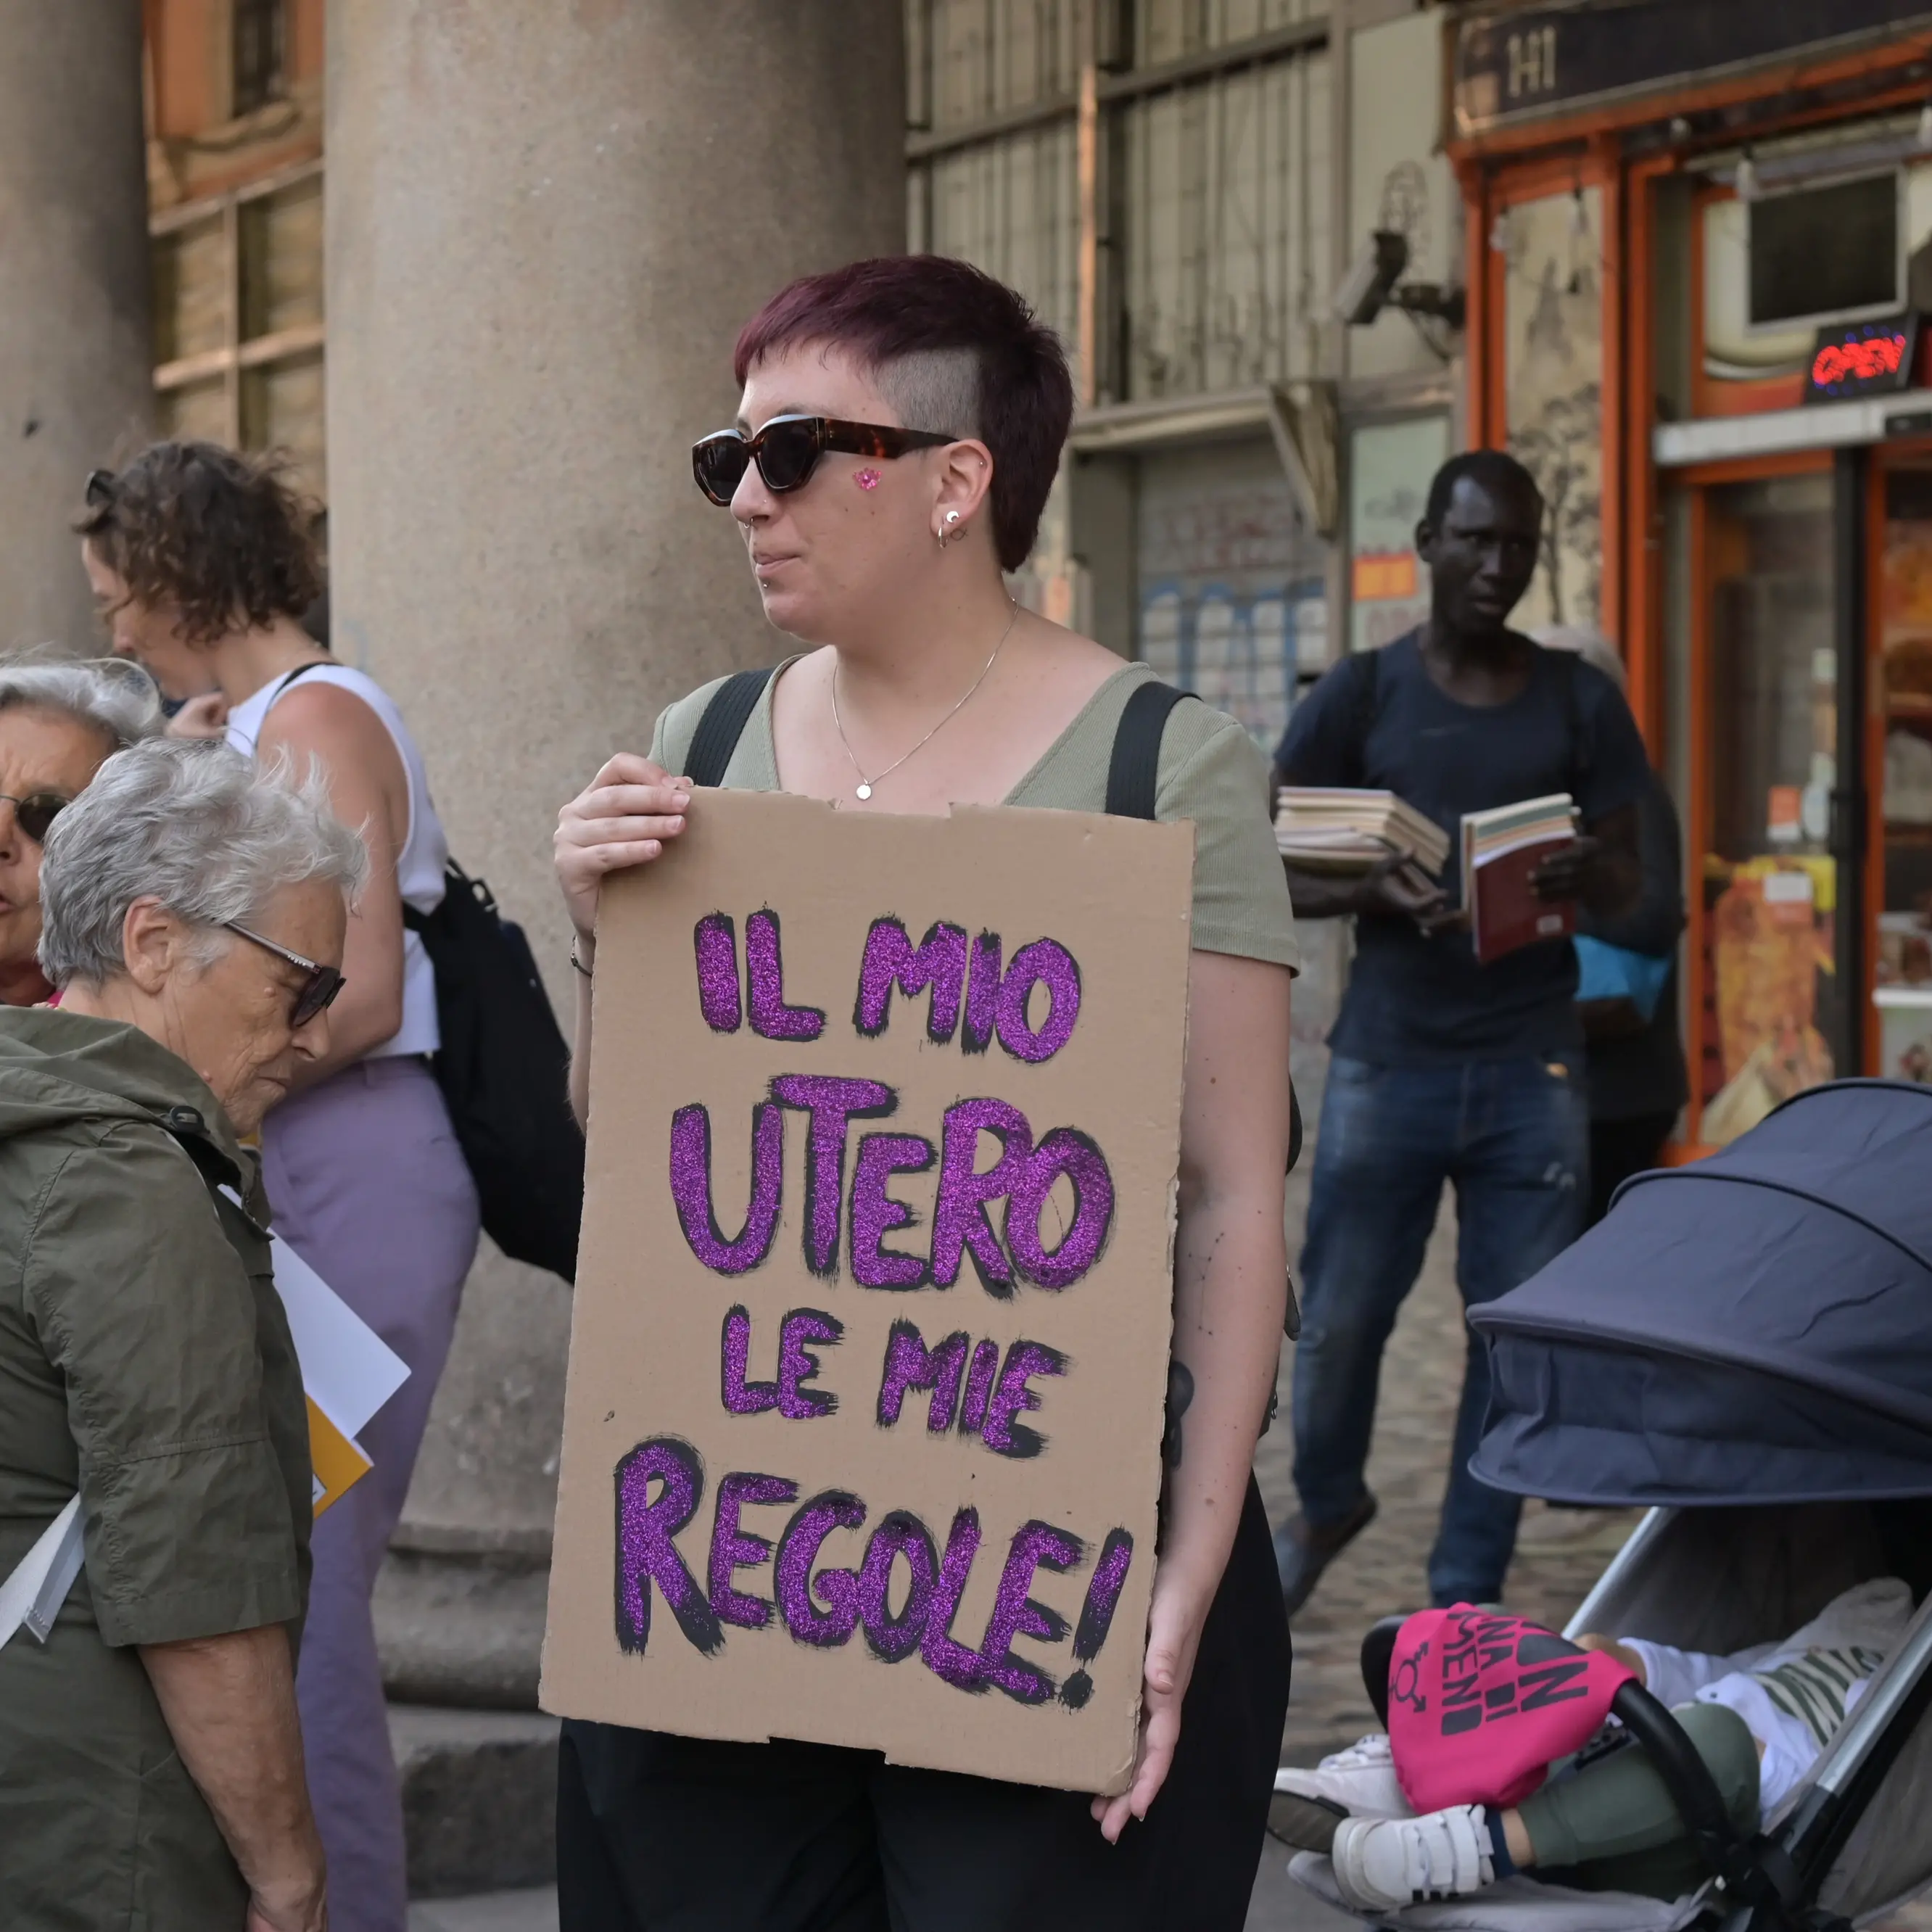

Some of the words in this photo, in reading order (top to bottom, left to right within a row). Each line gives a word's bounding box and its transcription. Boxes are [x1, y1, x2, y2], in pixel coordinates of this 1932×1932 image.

[694, 906, 826, 1042] IL
[852, 914, 1081, 1064] MIO
[669, 1074, 1115, 1300] UTERO
[721, 1304, 845, 1419] LE
[876, 1318, 1069, 1458] MIE
[614, 1436, 1134, 1712] REGOLE!
[1477, 1618, 1517, 1671] NA
[1516, 1621, 1588, 1712] ON
